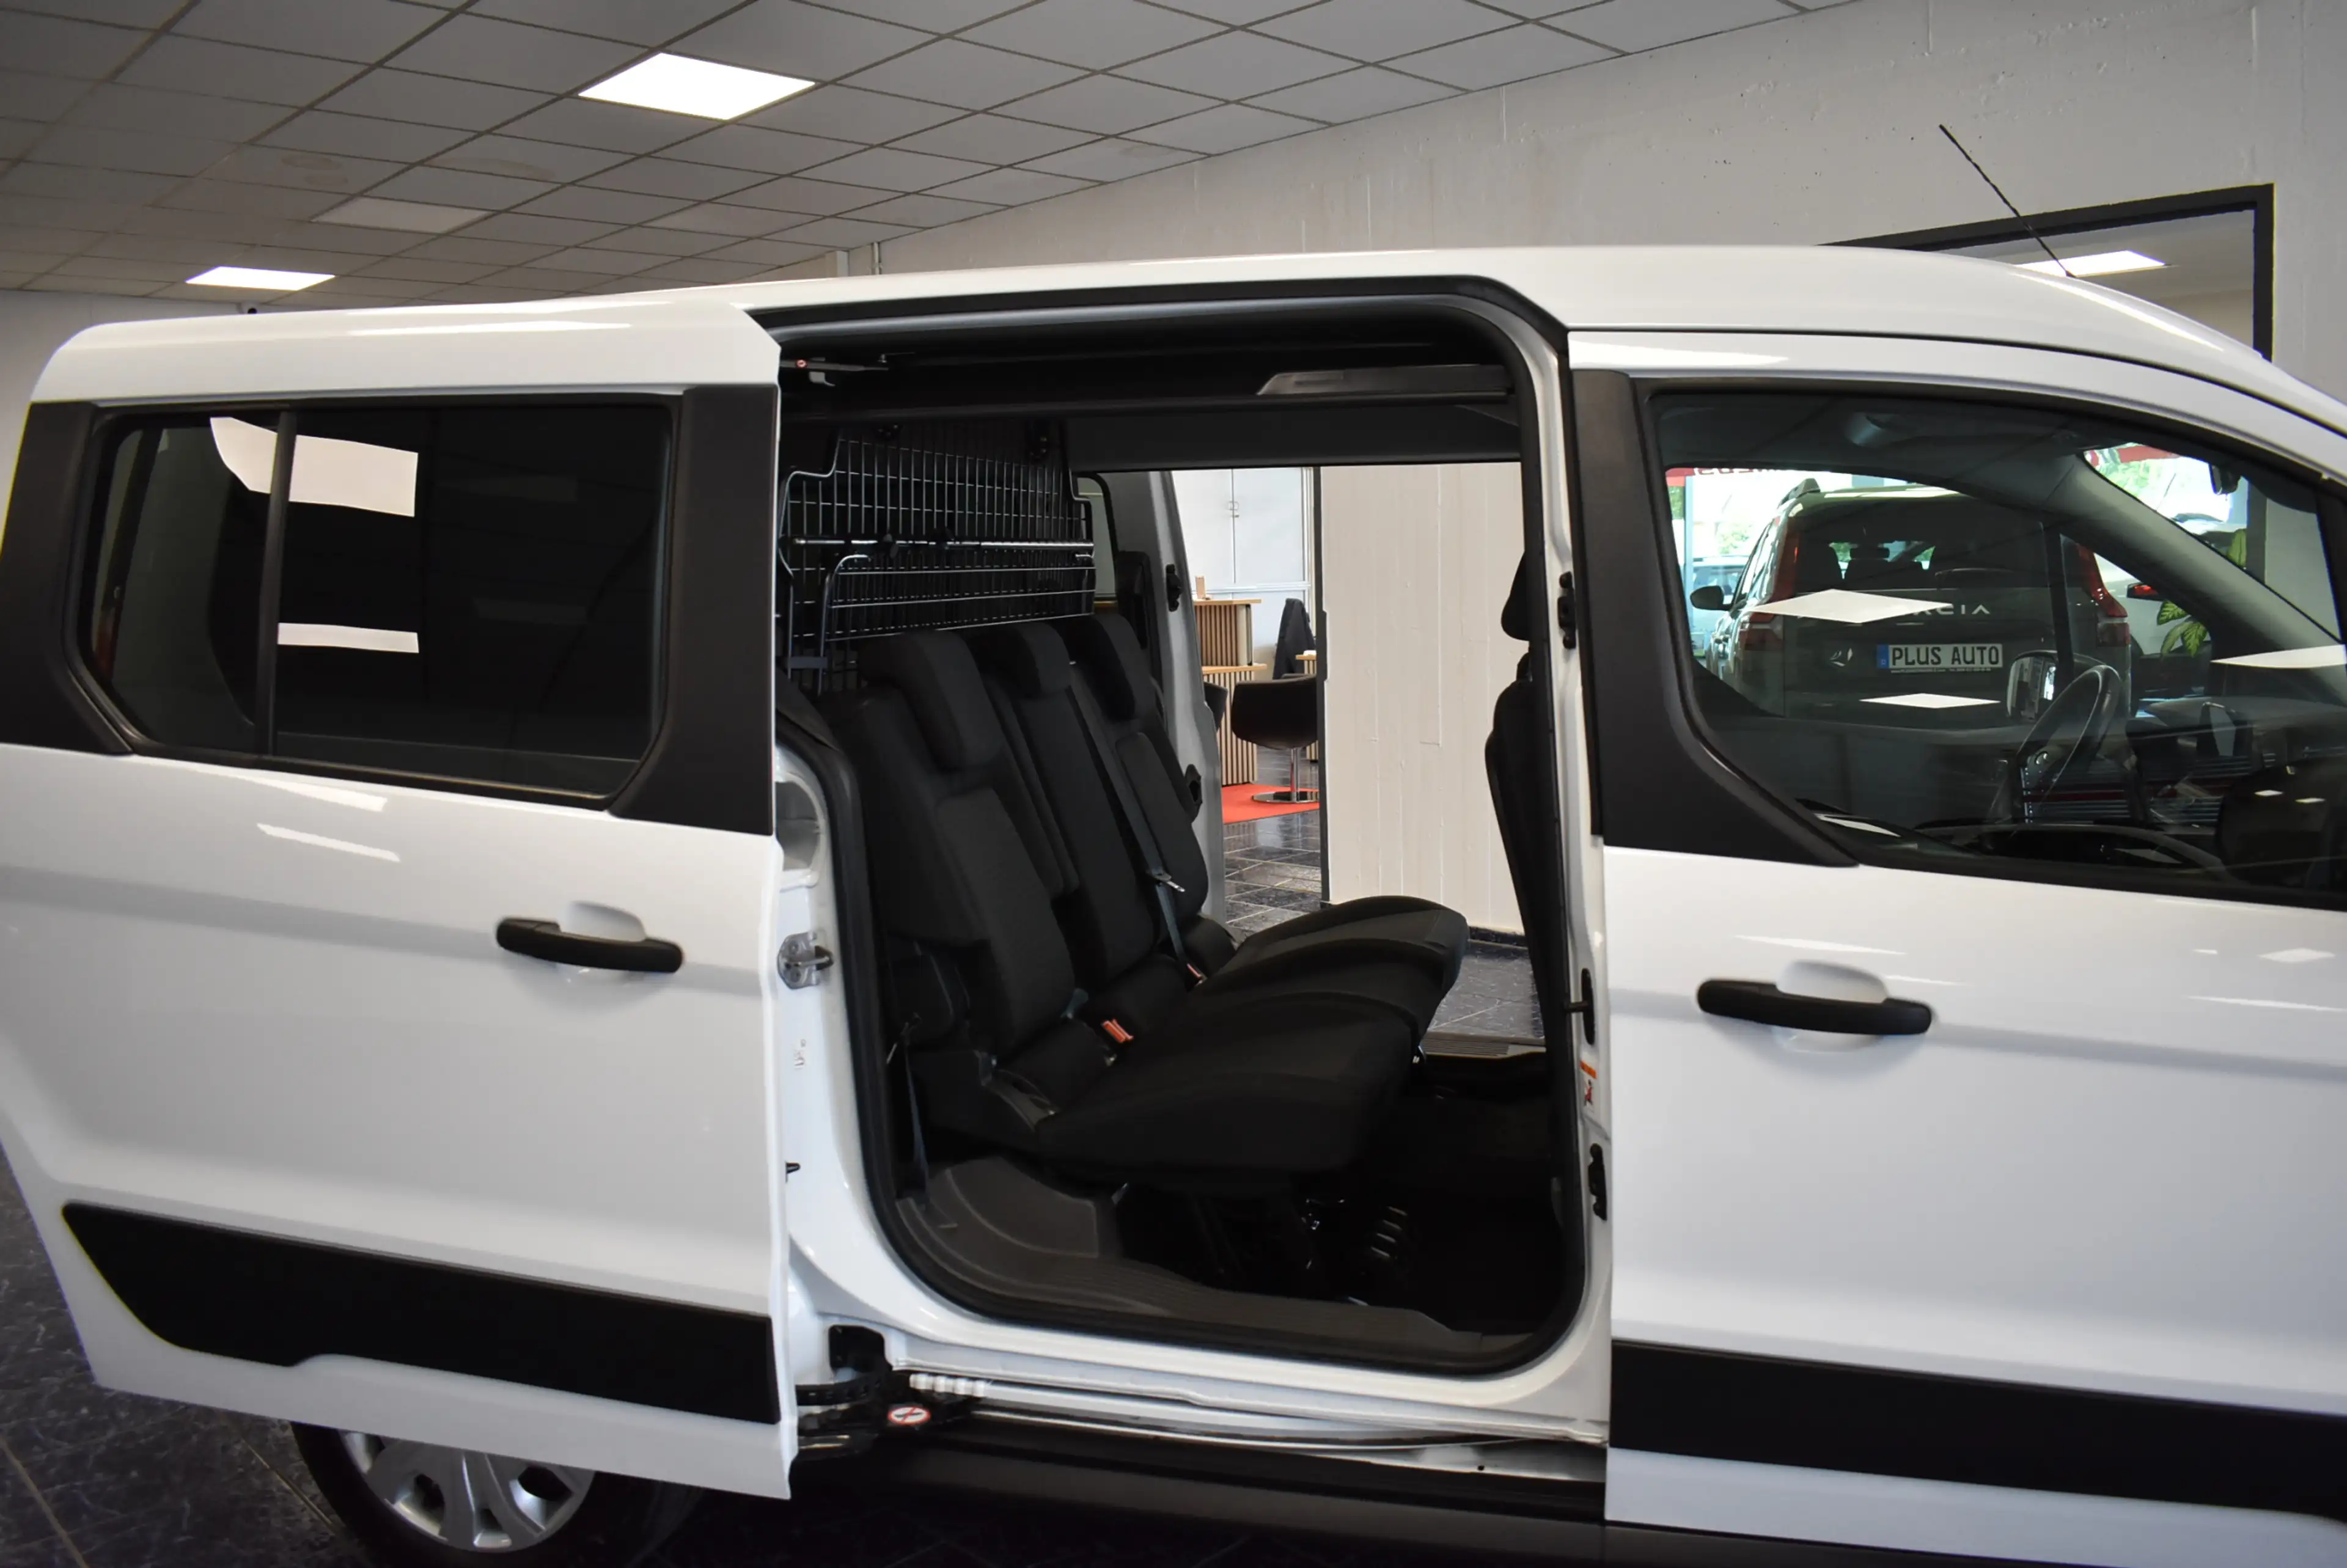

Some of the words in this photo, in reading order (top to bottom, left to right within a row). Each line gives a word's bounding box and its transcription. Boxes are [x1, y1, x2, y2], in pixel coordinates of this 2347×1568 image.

[1913, 604, 1990, 615] CIA
[1892, 647, 1941, 665] PLUS
[1951, 646, 1999, 665] AUTO
